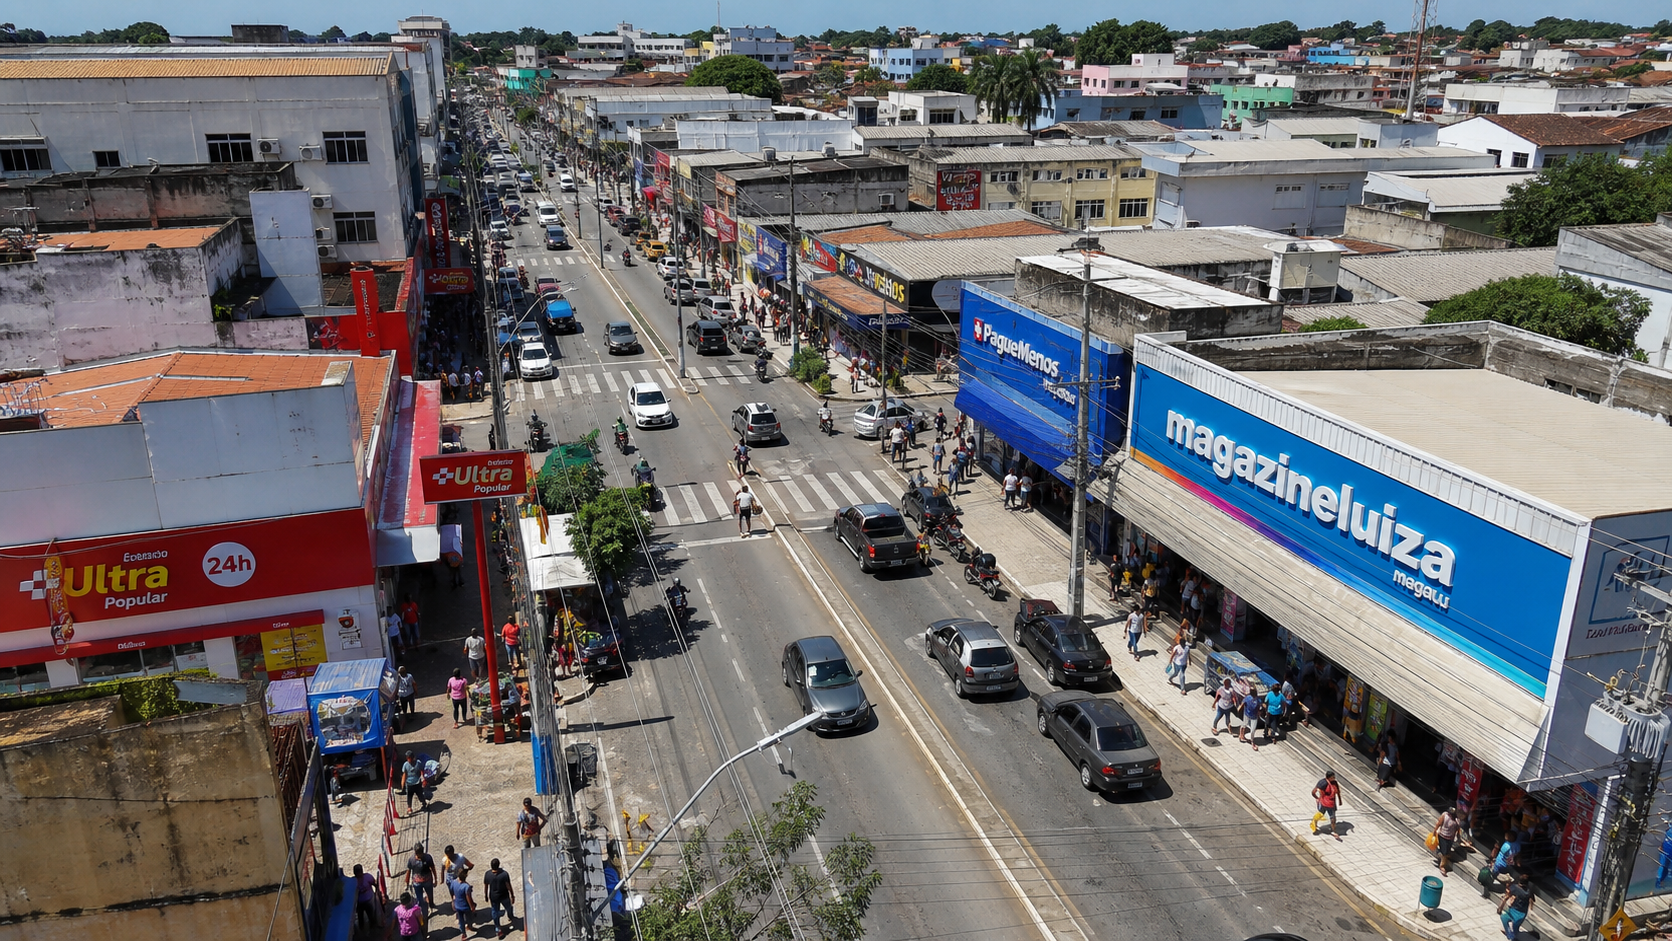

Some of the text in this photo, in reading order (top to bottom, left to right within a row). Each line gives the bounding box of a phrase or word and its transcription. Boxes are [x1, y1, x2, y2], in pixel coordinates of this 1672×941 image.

[983, 322, 1060, 377] PagueMenos
[454, 465, 513, 485] Ultra
[473, 483, 512, 494] Popular
[1166, 409, 1457, 588] magazineluiza
[206, 554, 252, 575] 24h
[64, 564, 168, 597] Ultra
[104, 592, 168, 610] Popular
